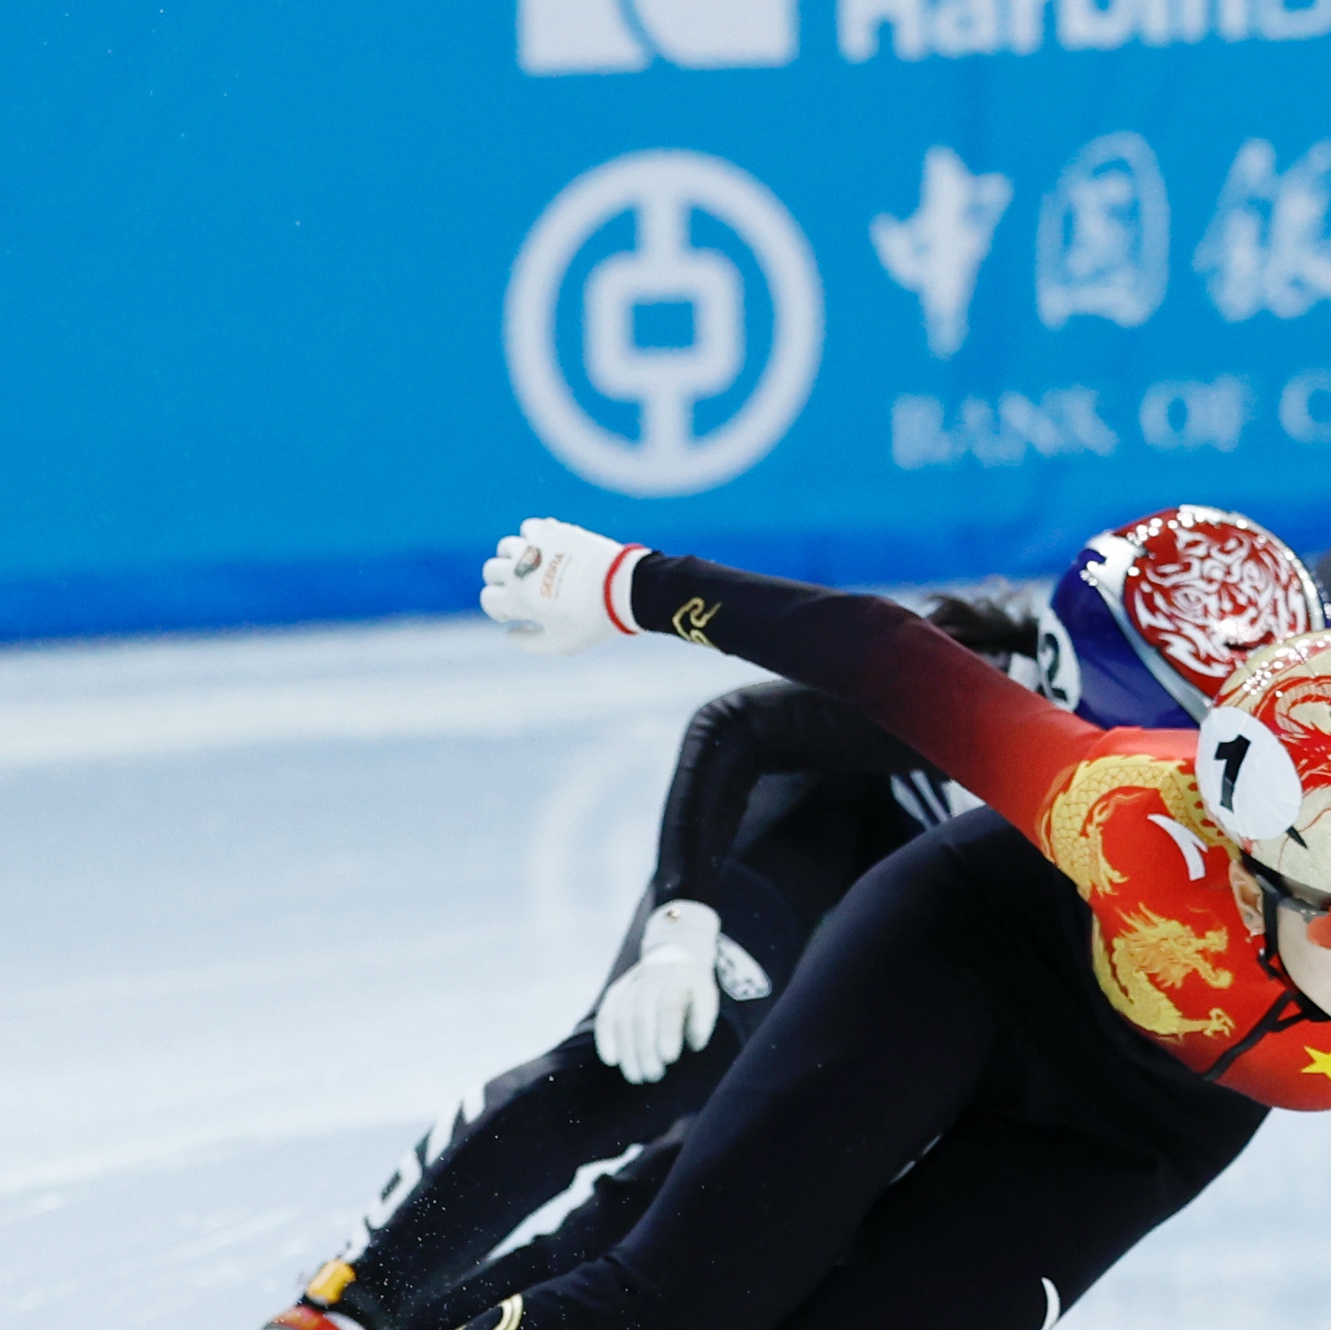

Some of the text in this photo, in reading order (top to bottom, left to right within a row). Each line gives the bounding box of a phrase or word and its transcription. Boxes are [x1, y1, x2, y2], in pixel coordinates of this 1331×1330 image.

[891, 383, 1120, 469] BANK
[1140, 372, 1256, 452] OF
[1213, 733, 1252, 813] 1
